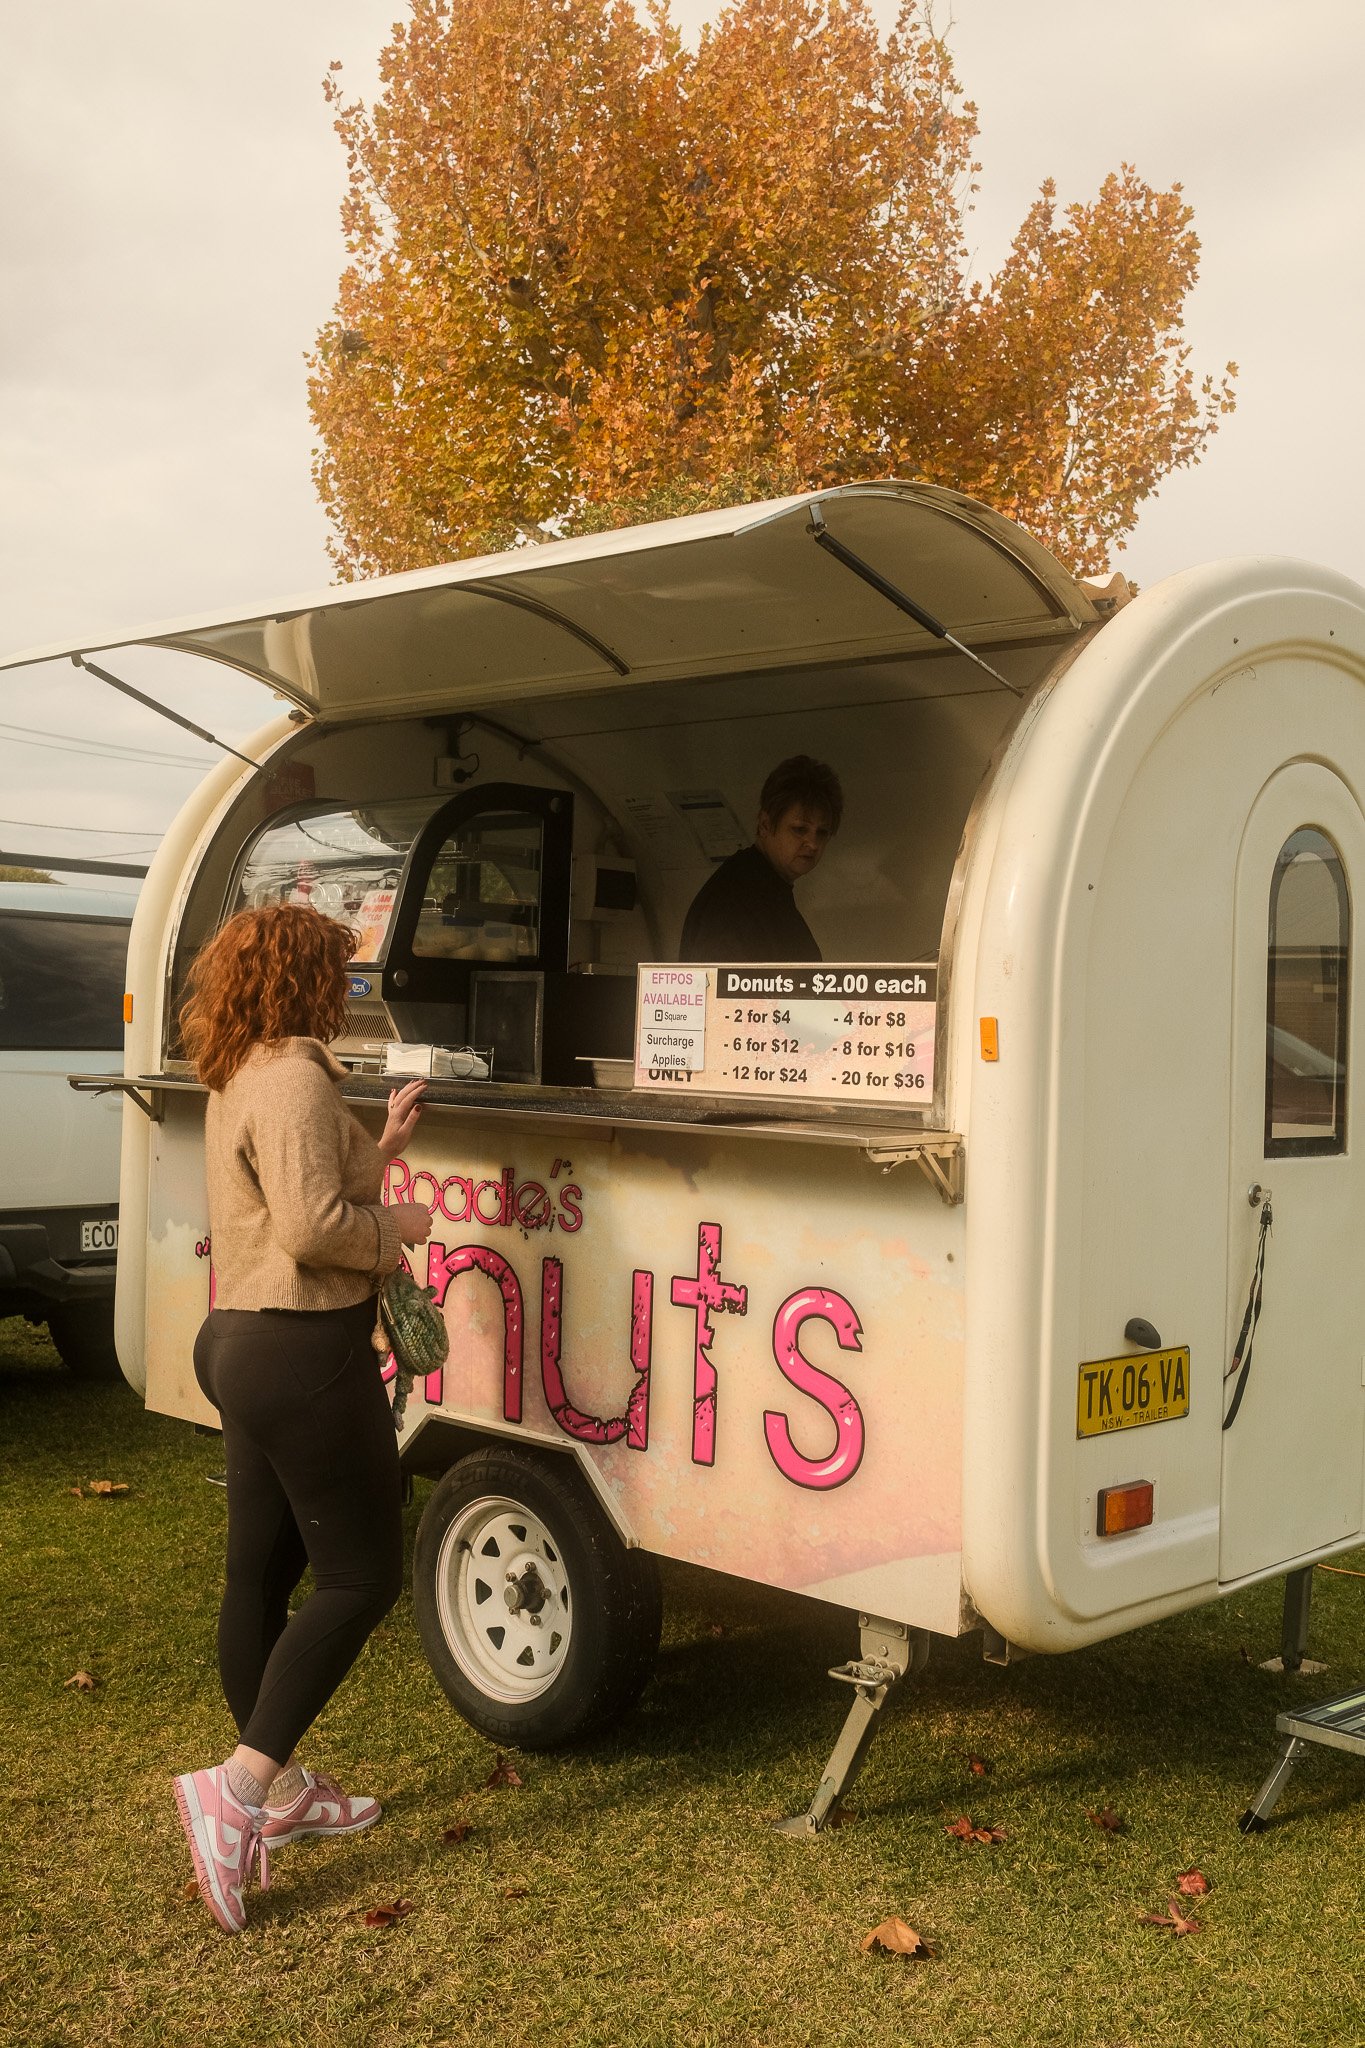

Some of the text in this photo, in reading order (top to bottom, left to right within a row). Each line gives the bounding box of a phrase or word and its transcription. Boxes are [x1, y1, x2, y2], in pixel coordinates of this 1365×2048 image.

[652, 972, 693, 985] EFTPOS
[727, 974, 794, 992] Donuts
[812, 973, 868, 994] $2.00
[874, 974, 926, 994] each
[644, 993, 704, 1006] AVAILABLE
[664, 1012, 687, 1022] Square
[734, 1009, 742, 1022] 2
[748, 1010, 768, 1023] for
[772, 1010, 790, 1025] $4
[844, 1012, 853, 1025] 4
[858, 1012, 881, 1026] for
[886, 1012, 906, 1028] $8
[647, 1034, 694, 1050] Surcharge
[733, 1038, 742, 1051] 6
[746, 1038, 767, 1052] for
[772, 1038, 798, 1054] $12
[842, 1041, 852, 1055] 8
[858, 1042, 880, 1056] for
[885, 1042, 915, 1058] $16
[652, 1054, 686, 1068] Applies
[648, 1069, 693, 1082] ONLY
[732, 1066, 750, 1080] 12
[754, 1066, 775, 1080] for
[780, 1068, 808, 1083] $24
[842, 1070, 860, 1086] 20
[866, 1072, 889, 1086] for
[894, 1072, 924, 1089] $36
[383, 1158, 583, 1233] Roadie's
[92, 1225, 119, 1248] CO
[1102, 1416, 1123, 1431] NSW
[1133, 1406, 1168, 1422] TRAILER
